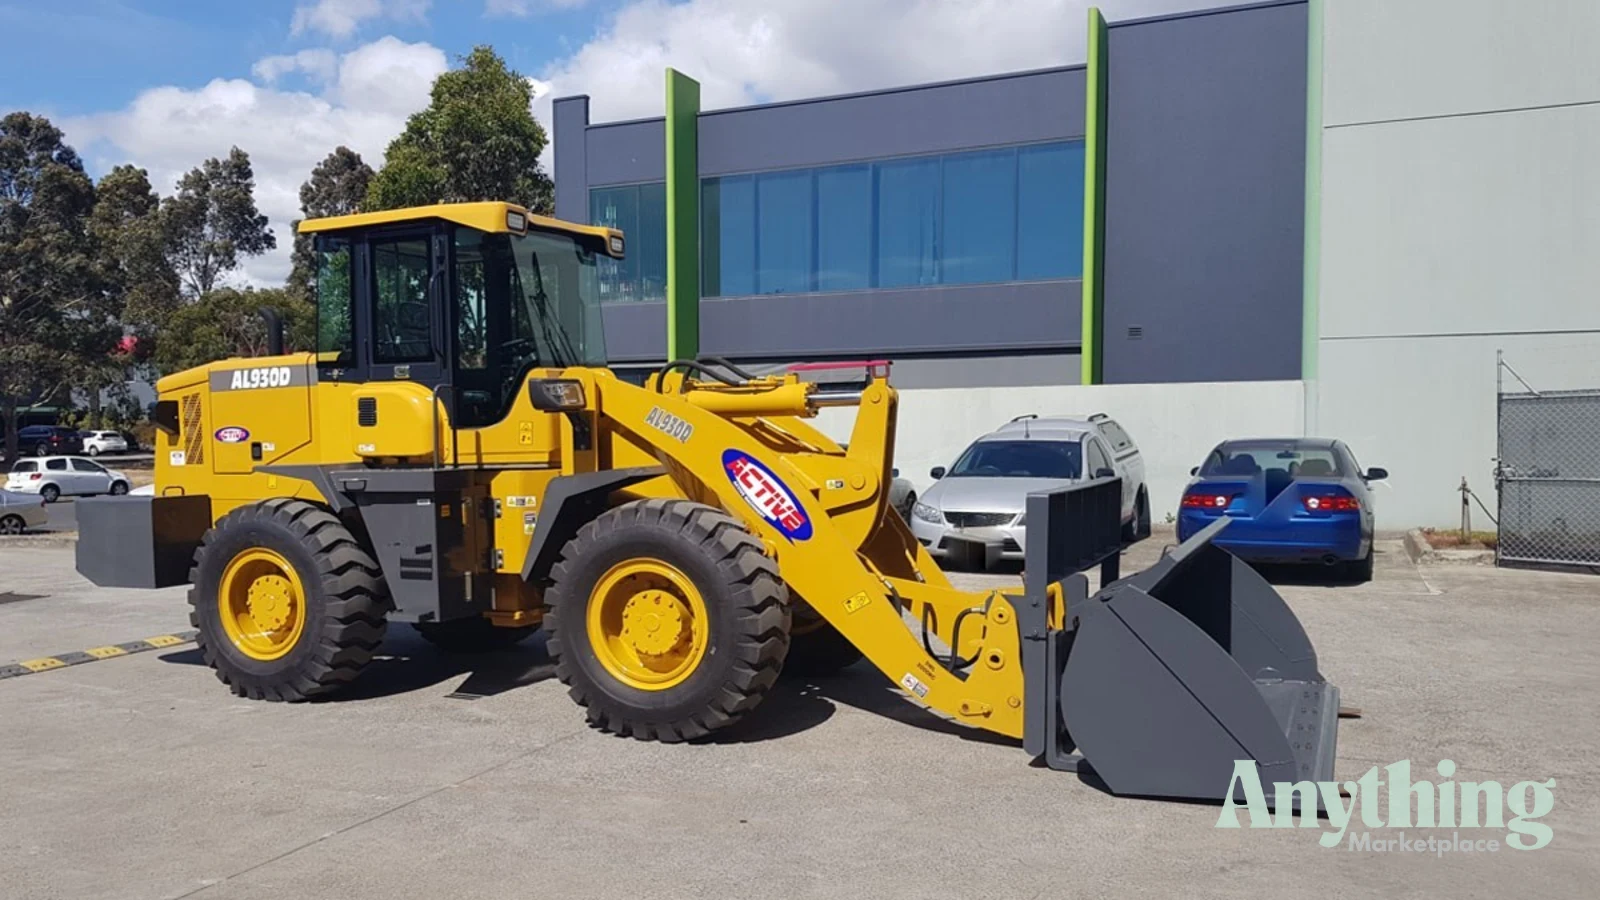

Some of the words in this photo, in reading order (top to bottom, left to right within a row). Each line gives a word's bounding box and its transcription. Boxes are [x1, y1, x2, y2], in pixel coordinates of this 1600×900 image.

[231, 367, 290, 389] AL930D
[644, 404, 694, 443] AL930D
[726, 456, 807, 532] ACTIVE
